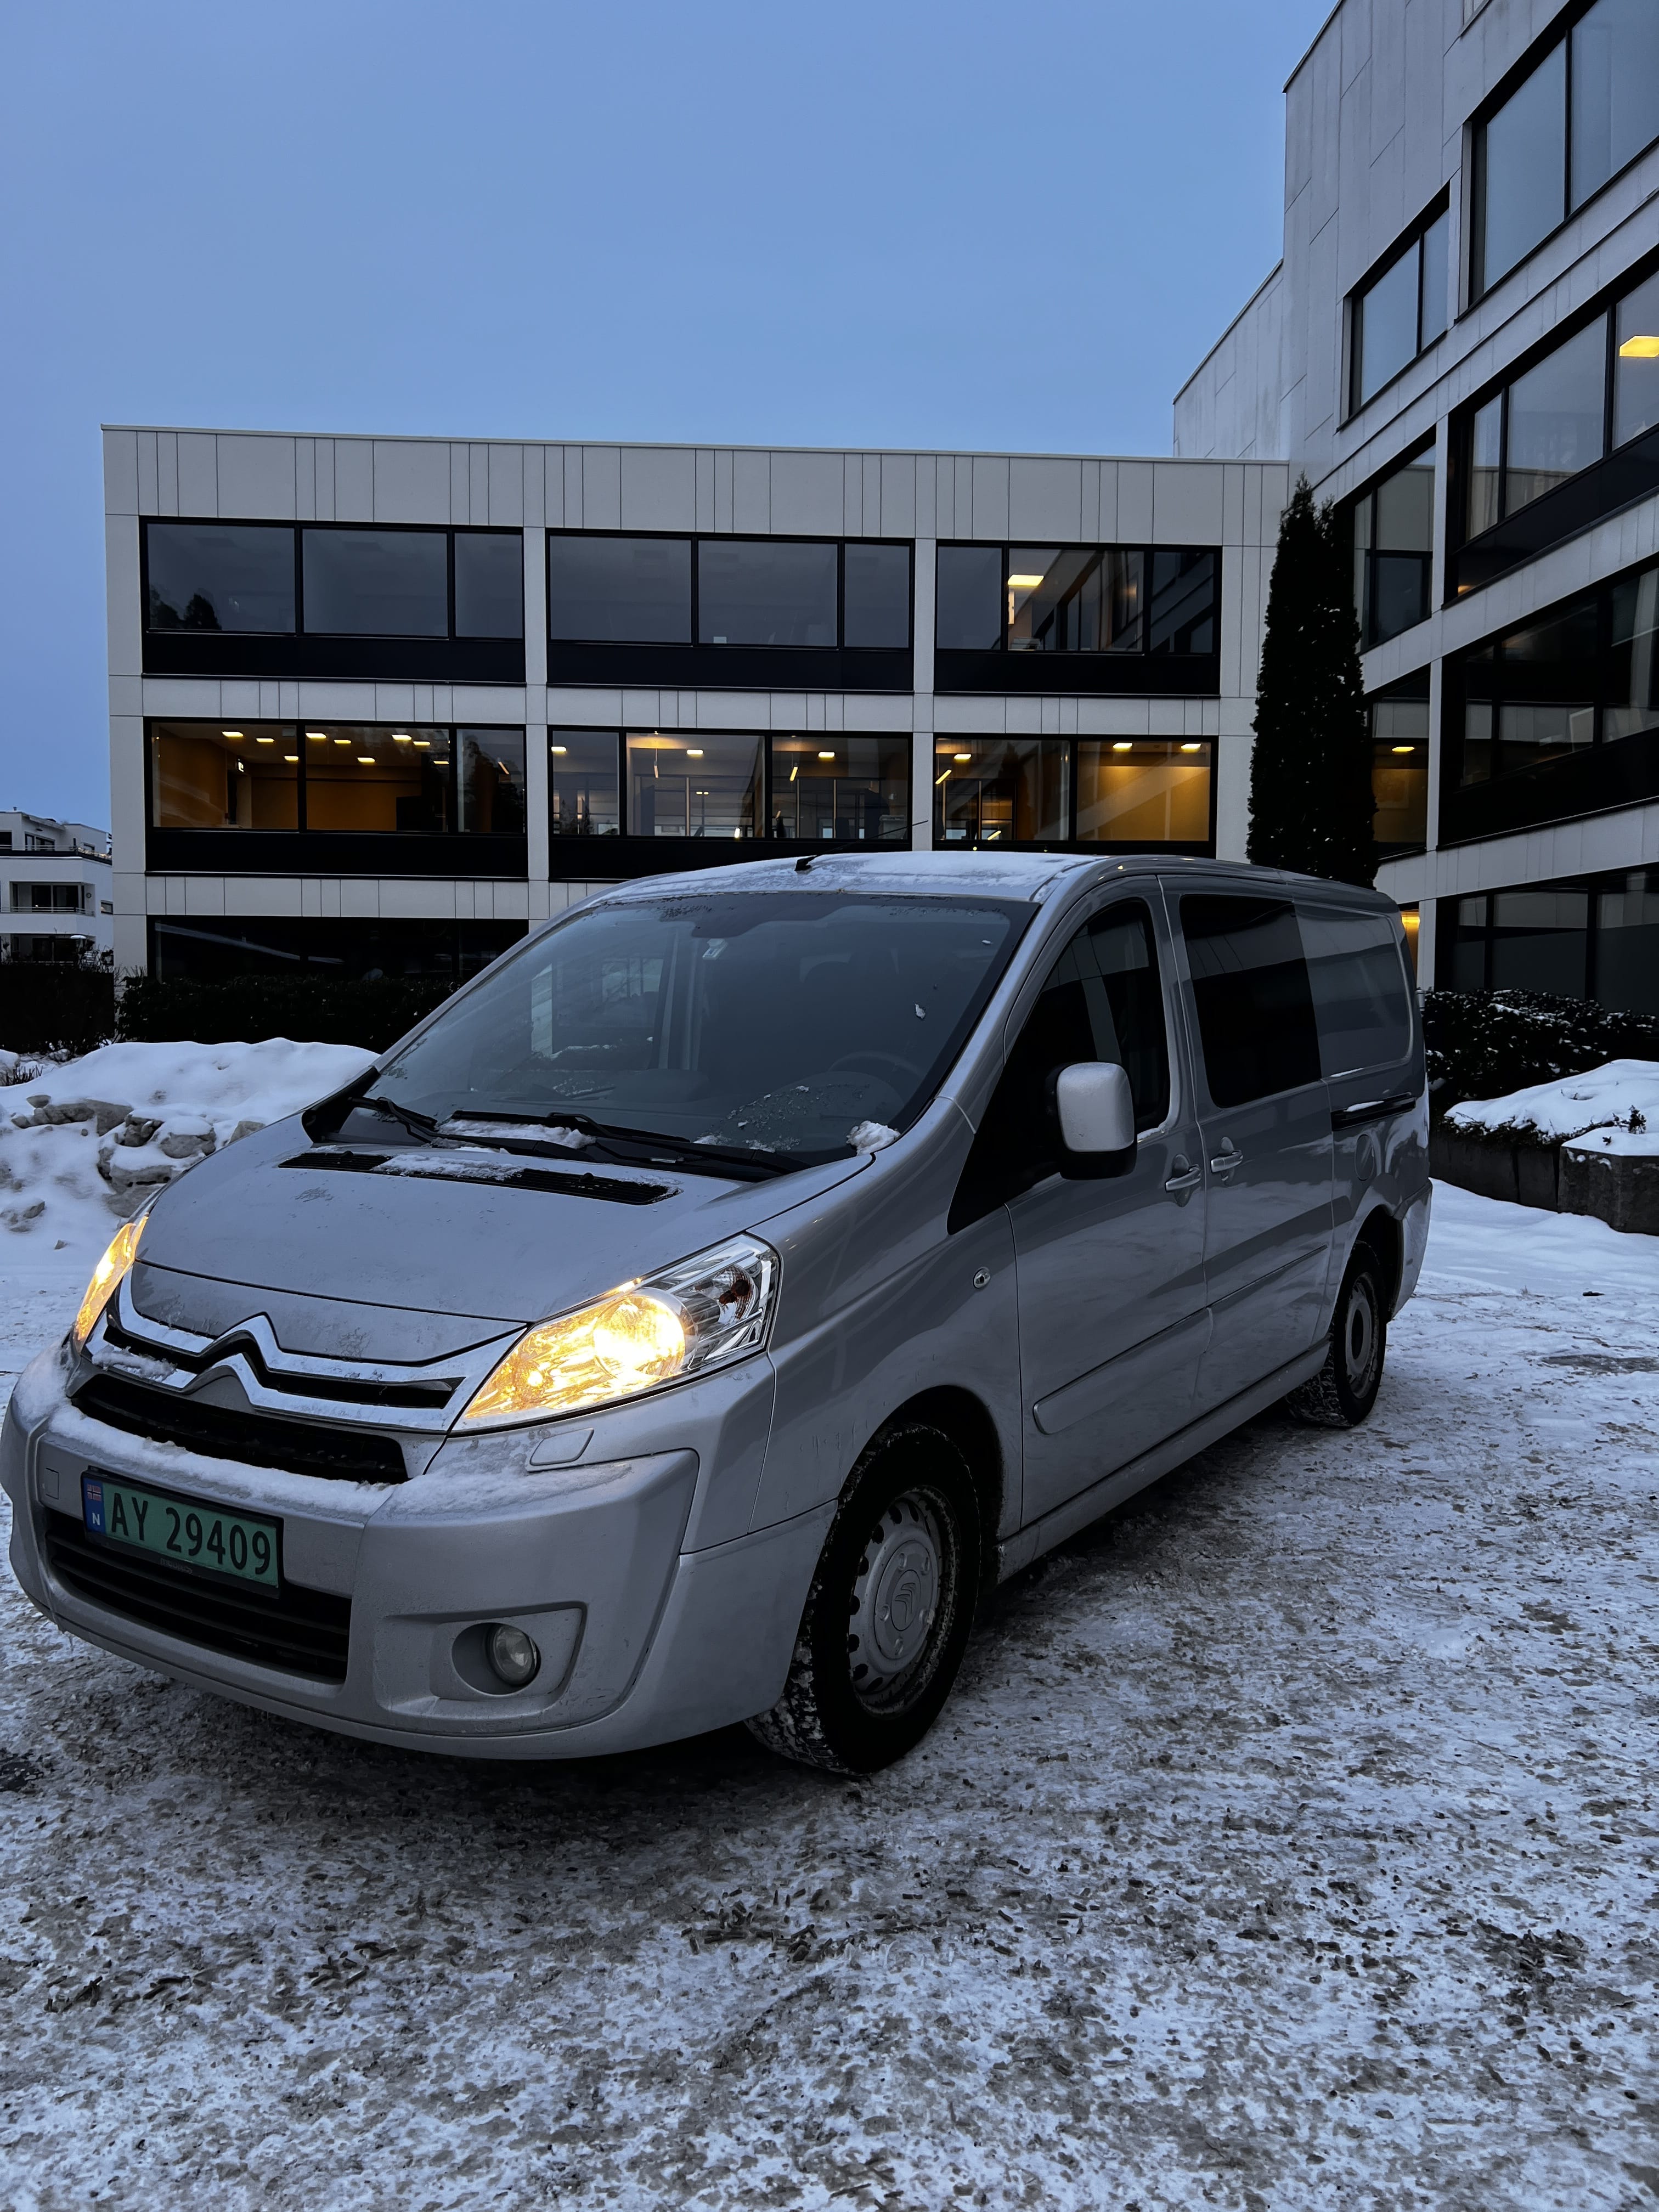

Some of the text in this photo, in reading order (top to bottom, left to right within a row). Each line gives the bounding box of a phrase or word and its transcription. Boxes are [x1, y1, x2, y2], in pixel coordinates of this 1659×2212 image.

[92, 1511, 100, 1526] N
[111, 1493, 270, 1575] AY 29409
